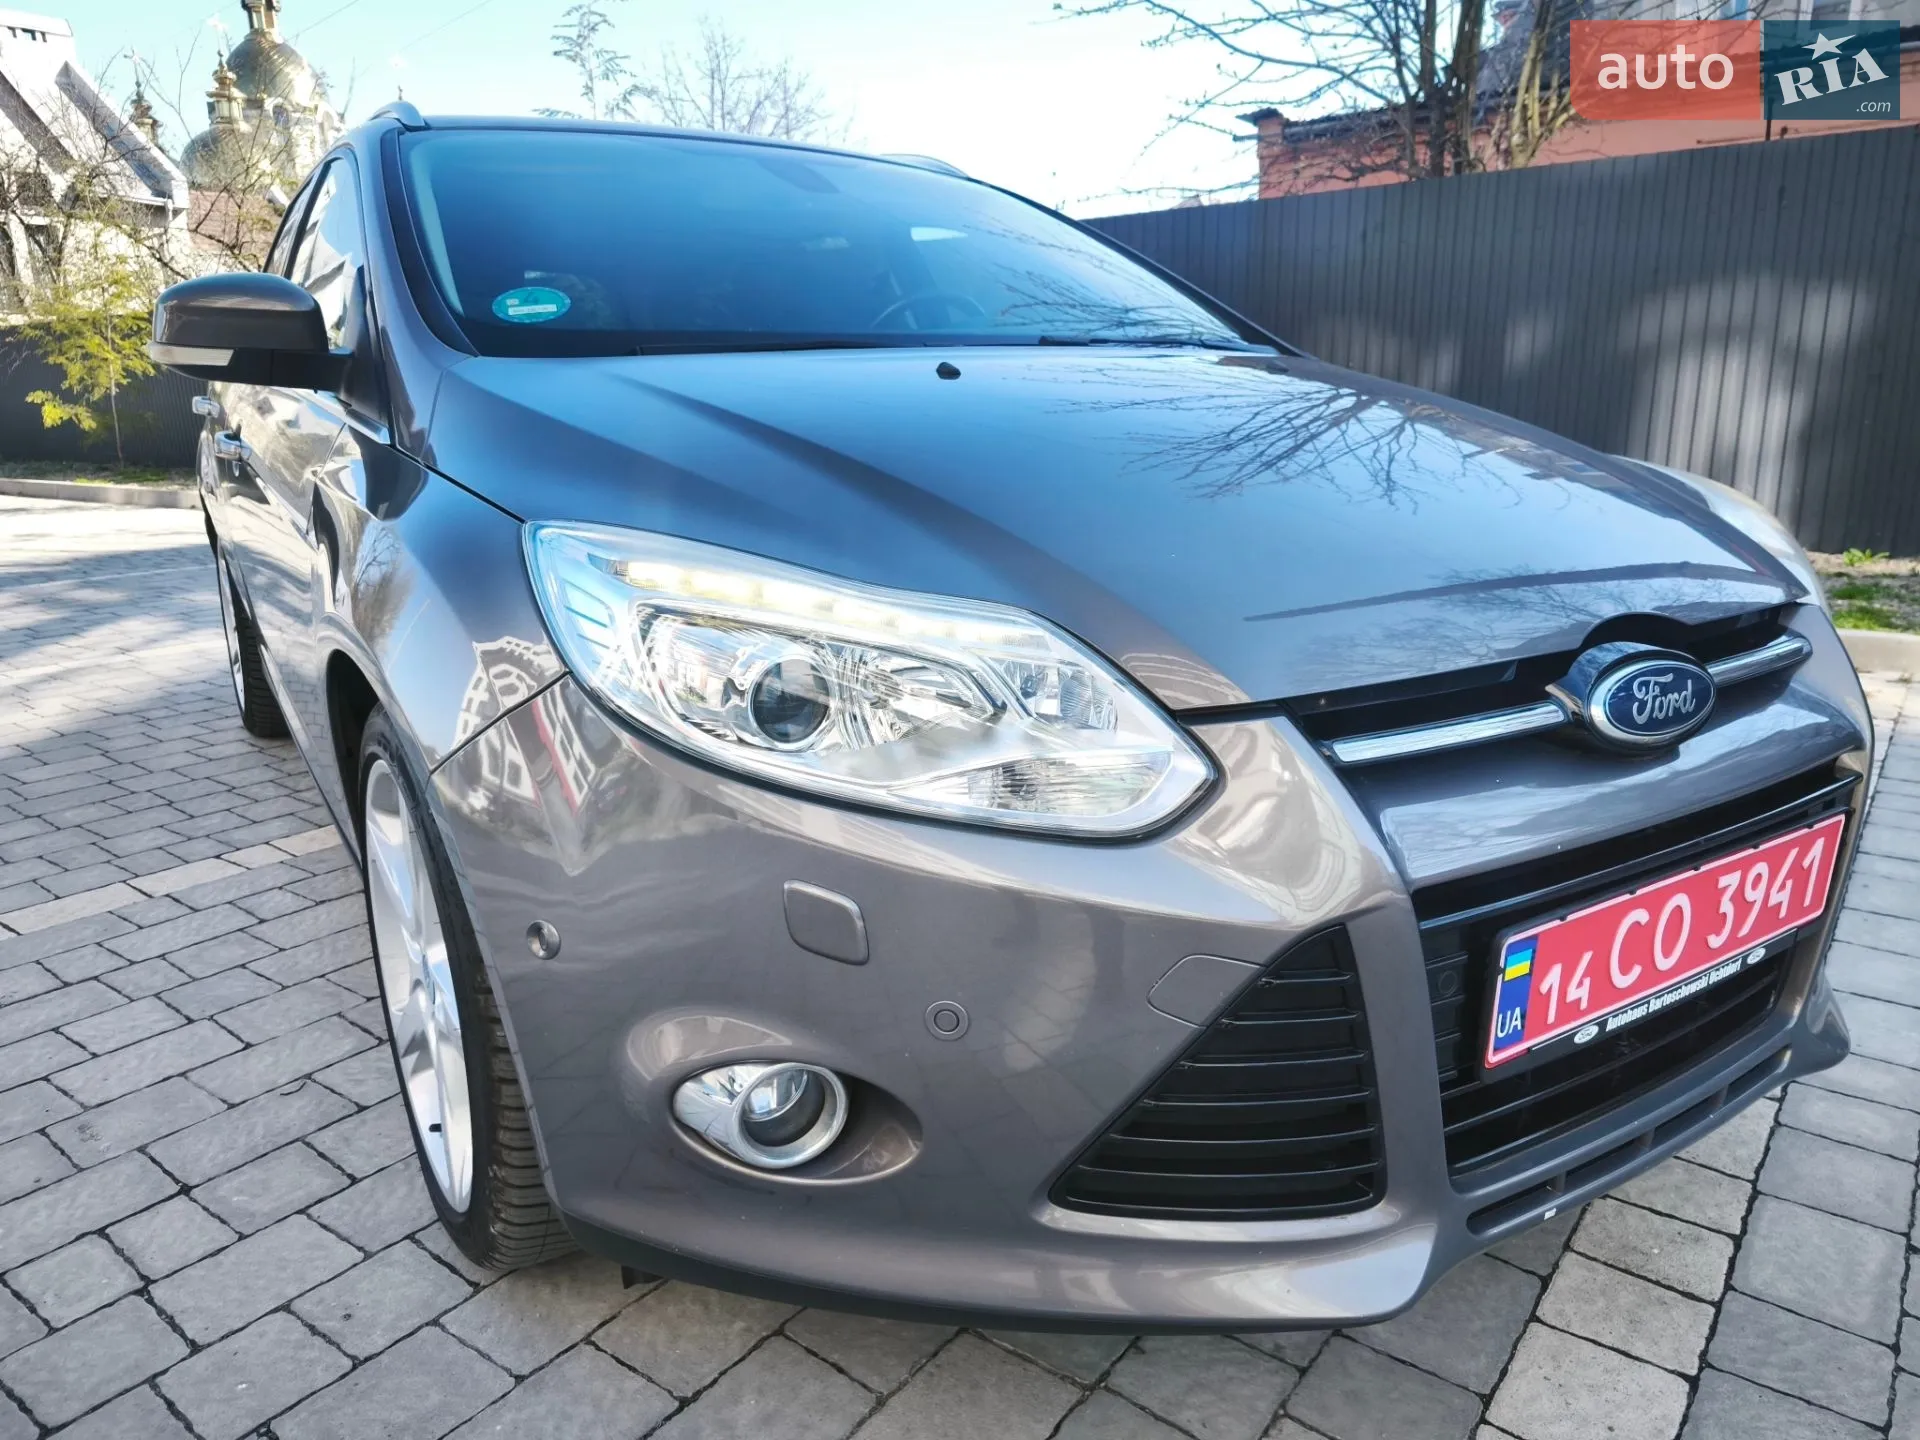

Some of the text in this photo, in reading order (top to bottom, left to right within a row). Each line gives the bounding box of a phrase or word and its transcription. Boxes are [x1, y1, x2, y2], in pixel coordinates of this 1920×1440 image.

[1632, 673, 1696, 725] Ford
[1539, 837, 1825, 1025] 14 CO 3941
[1497, 1006, 1522, 1039] UA
[1605, 1003, 1648, 1032] Autohaus
